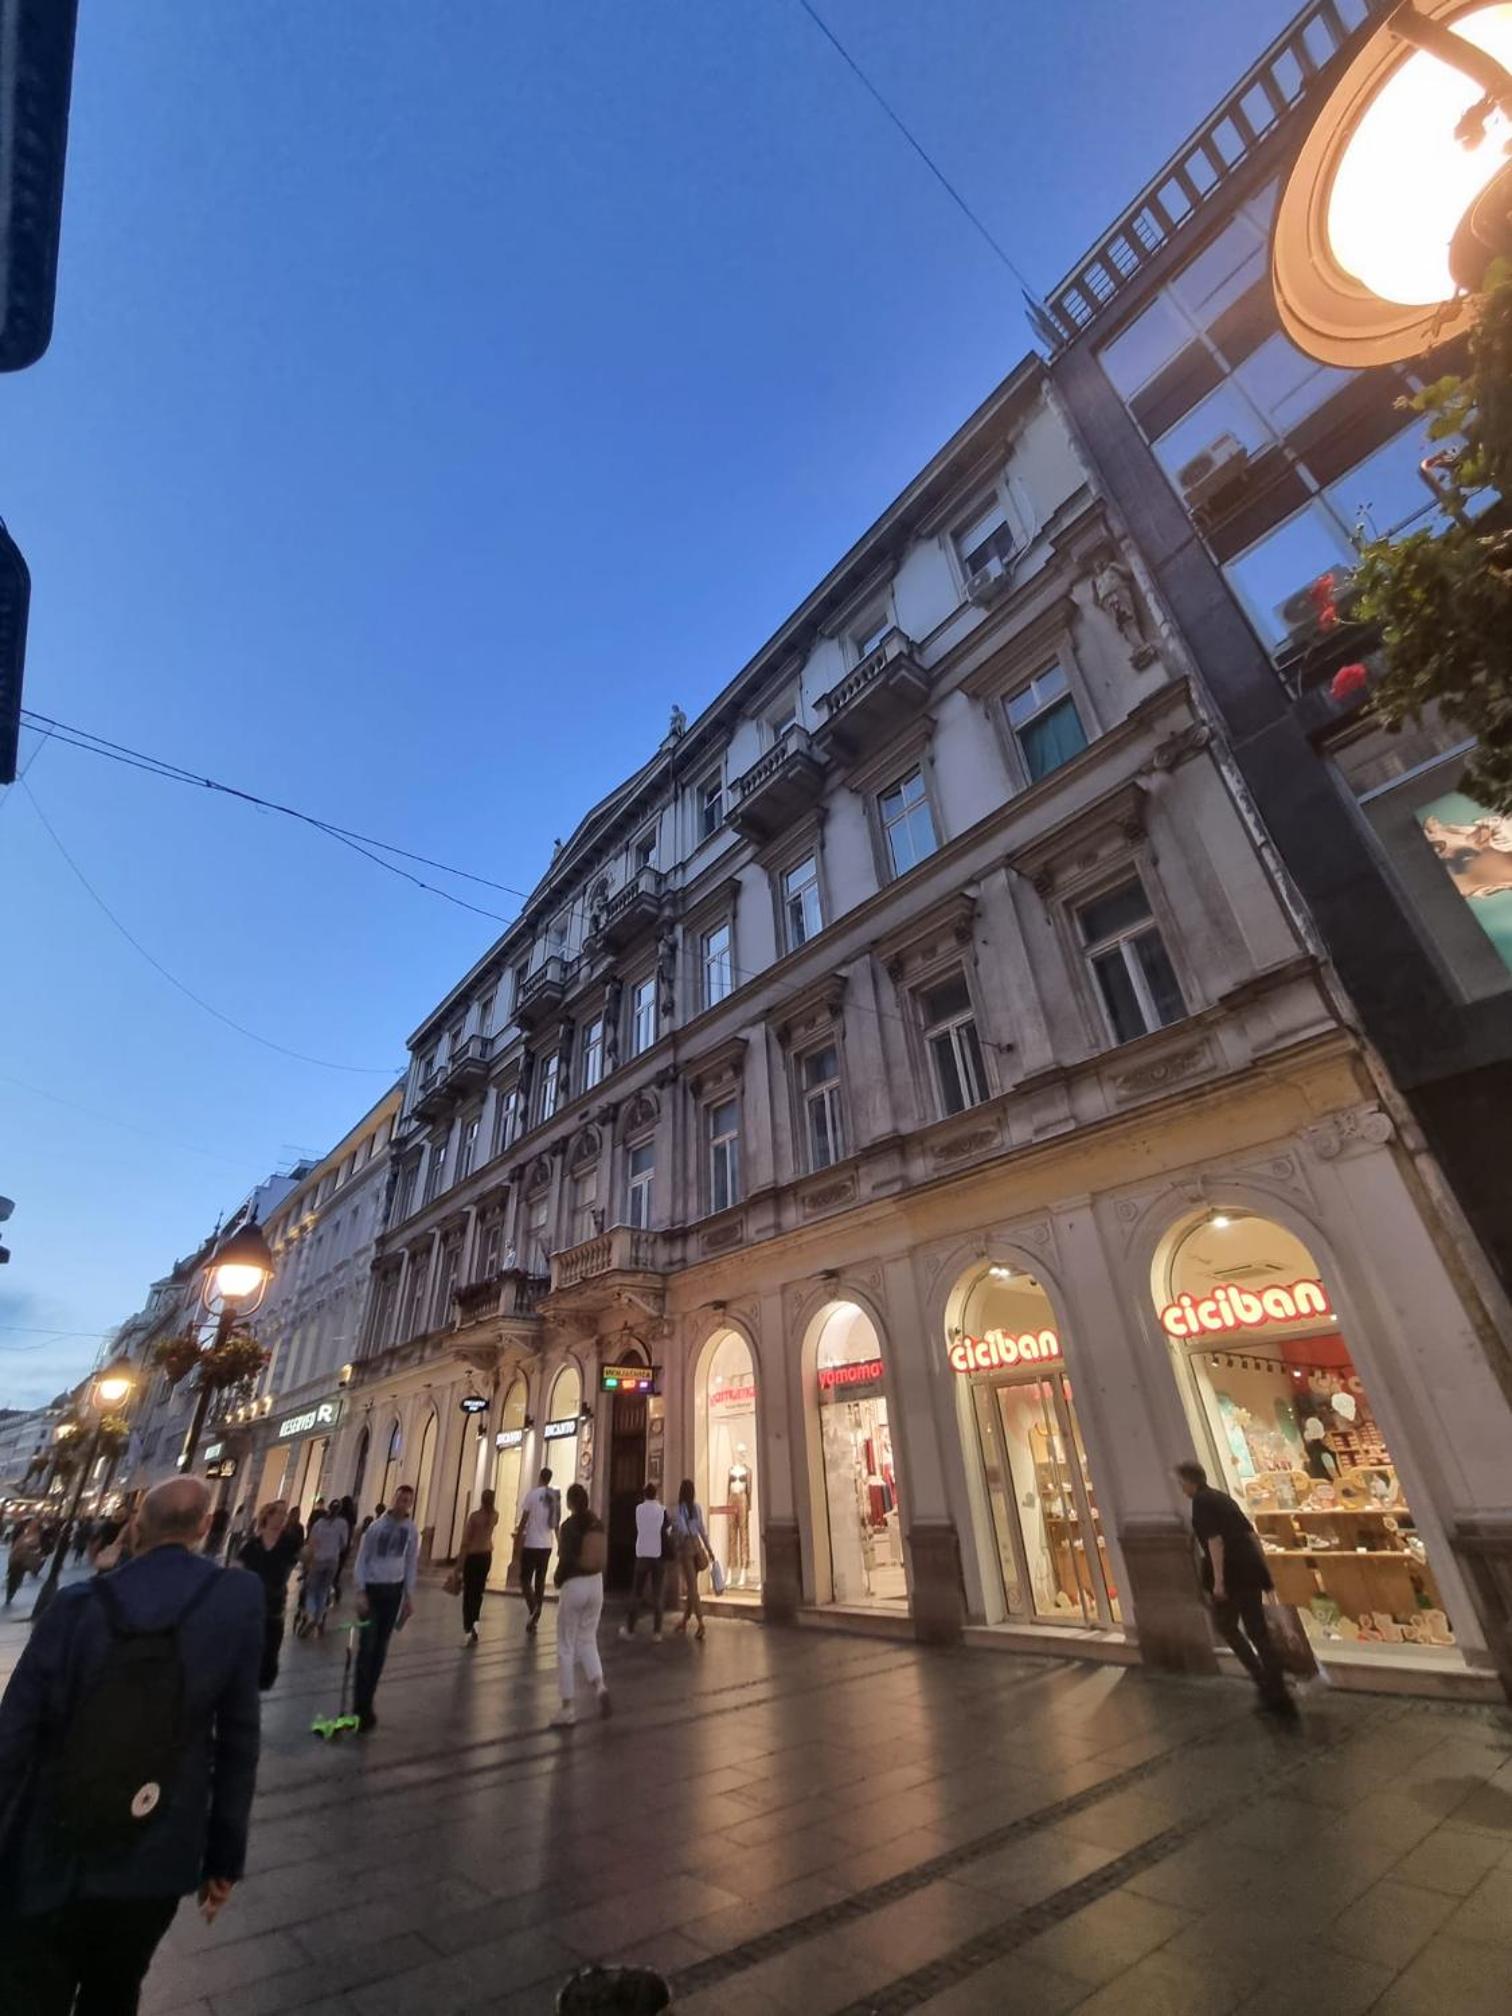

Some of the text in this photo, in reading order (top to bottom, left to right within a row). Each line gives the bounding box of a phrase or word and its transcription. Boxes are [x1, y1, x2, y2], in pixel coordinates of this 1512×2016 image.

[1162, 1282, 1327, 1335] ciciban
[950, 1330, 1059, 1370] ciciban
[317, 1404, 332, 1422] R
